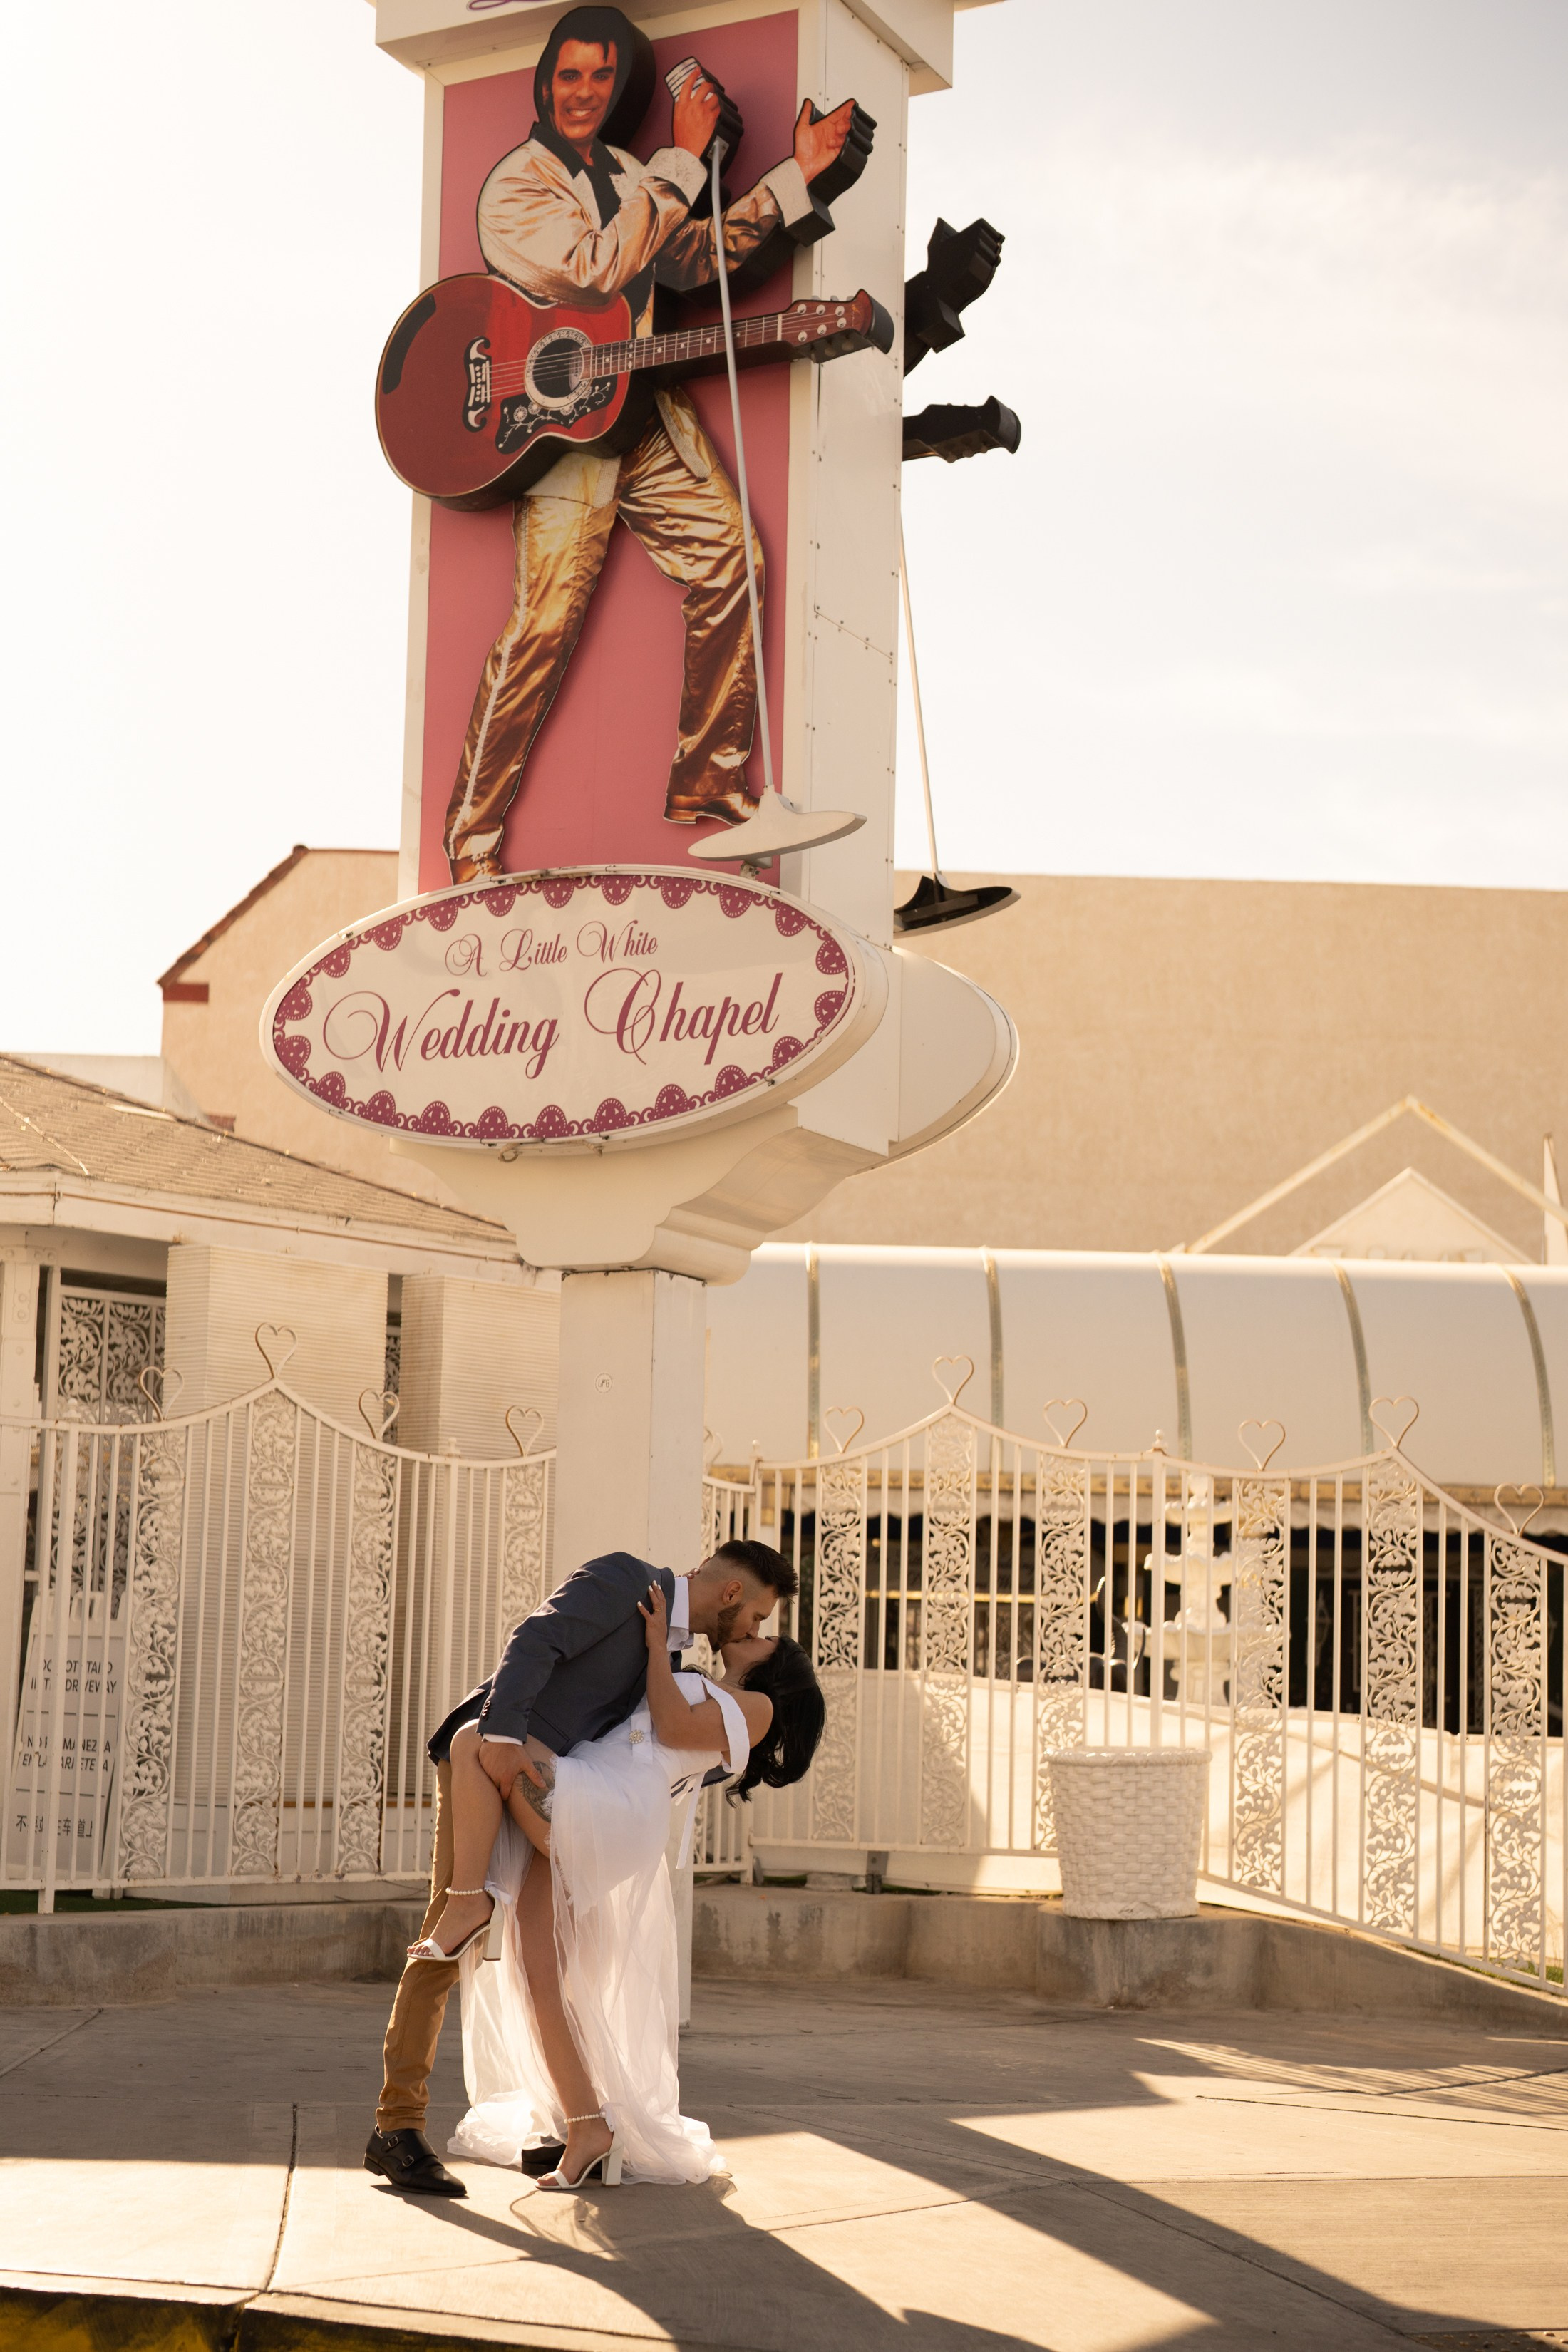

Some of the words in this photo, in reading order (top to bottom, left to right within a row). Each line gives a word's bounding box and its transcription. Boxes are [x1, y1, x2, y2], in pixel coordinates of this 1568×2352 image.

[445, 933, 488, 977] A
[499, 928, 568, 971] Little
[577, 919, 658, 964] White
[323, 989, 560, 1079] Wedding
[584, 967, 784, 1066] Chapel
[85, 1660, 113, 1674] TAD
[65, 1678, 117, 1693] DRVEWY
